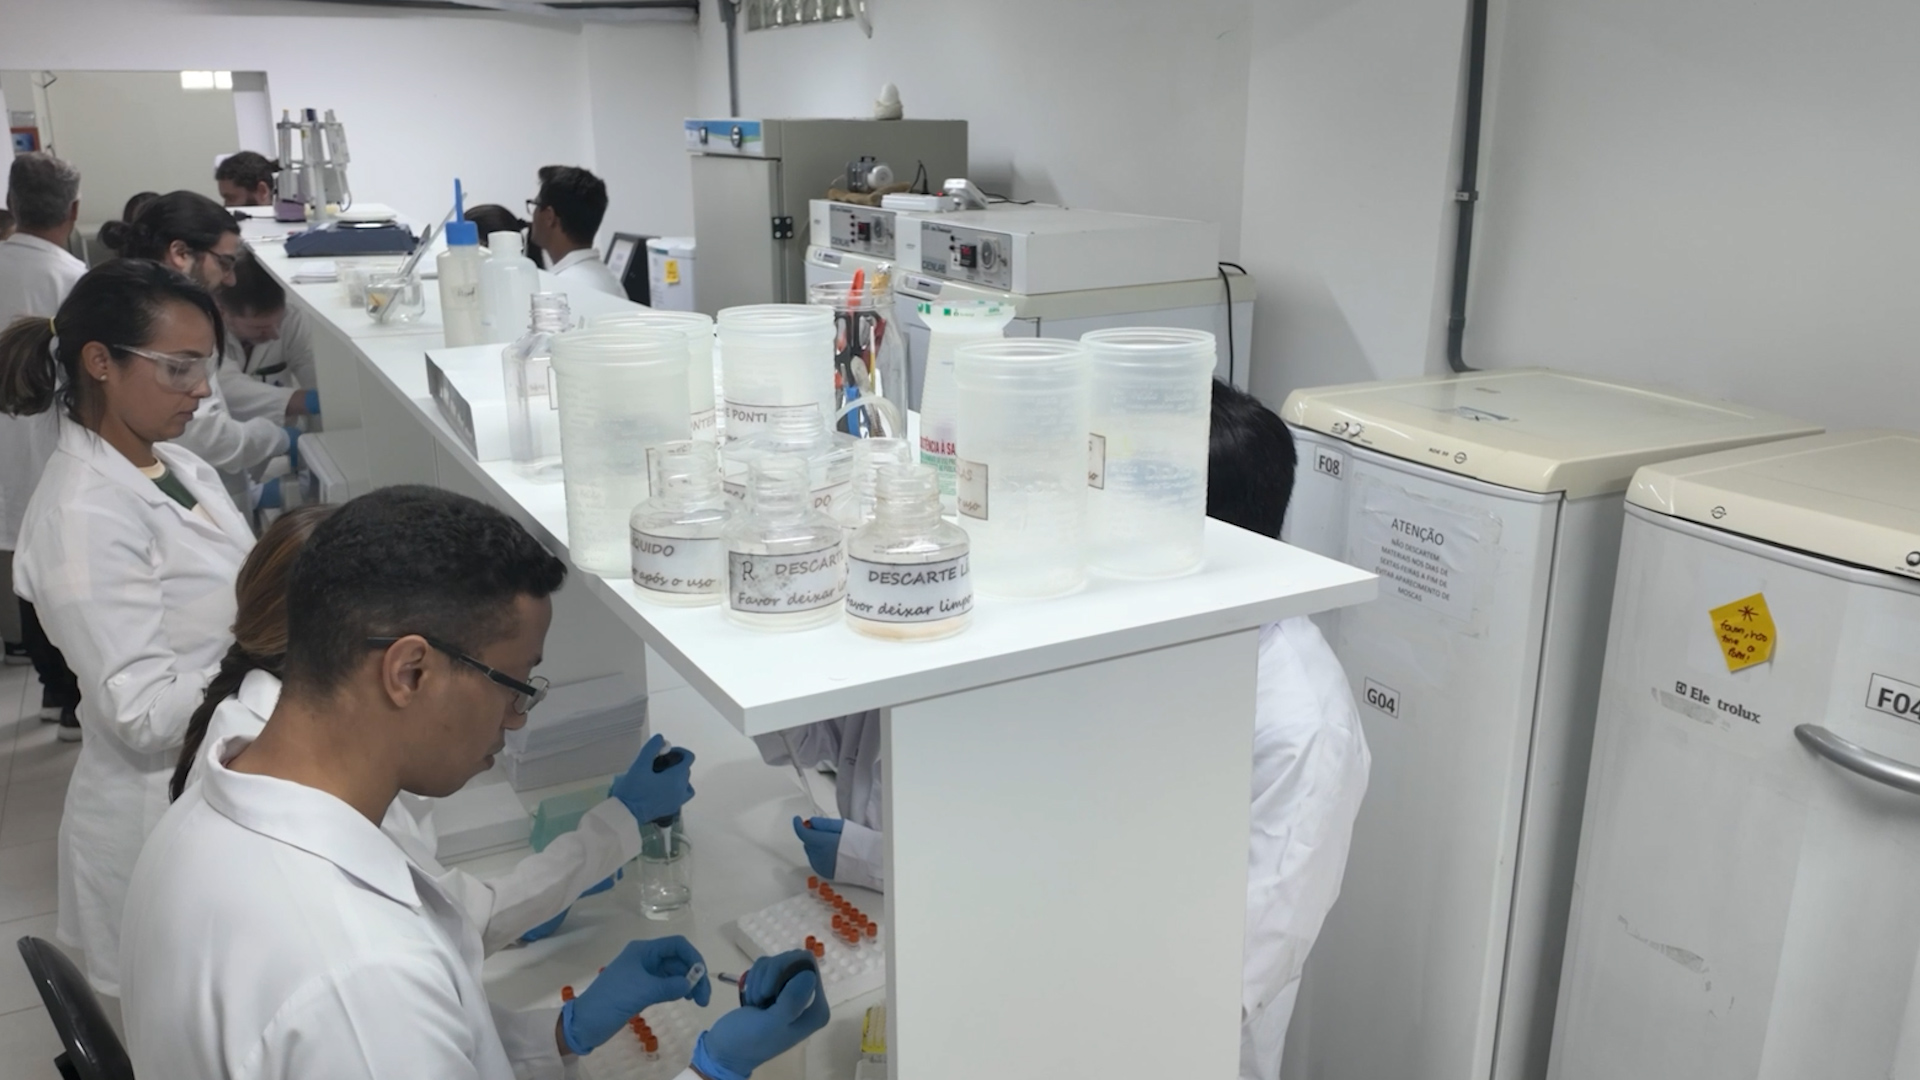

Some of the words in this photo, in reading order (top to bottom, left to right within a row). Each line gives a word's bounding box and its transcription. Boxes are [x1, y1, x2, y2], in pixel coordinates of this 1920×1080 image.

[1318, 454, 1340, 475] F08
[1391, 518, 1445, 546] ATENÇÃO
[1381, 546, 1411, 563] MATERIAIS
[1411, 557, 1425, 568] NOS
[1425, 561, 1439, 574] DIAS
[1440, 566, 1449, 577] DE
[1391, 538, 1404, 550] NÃO
[1404, 543, 1440, 562] DESCARTEM
[775, 549, 844, 576] DESCART
[639, 571, 668, 586] após
[671, 577, 683, 586] o
[686, 578, 716, 590] uso
[868, 565, 957, 586] DESCARTE
[1375, 566, 1395, 579] EVITAR
[1395, 574, 1441, 597] APARECIMENTO
[1441, 591, 1451, 602] DE
[1426, 574, 1439, 584] FIM
[1439, 579, 1448, 589] DE
[738, 592, 782, 607] Favor
[787, 587, 836, 606] deixar
[1398, 586, 1423, 602] MOSCAS
[878, 602, 934, 618] deixar
[1367, 687, 1396, 714] G04
[1690, 686, 1761, 724] Eletrolux
[1877, 687, 1920, 720] F04
